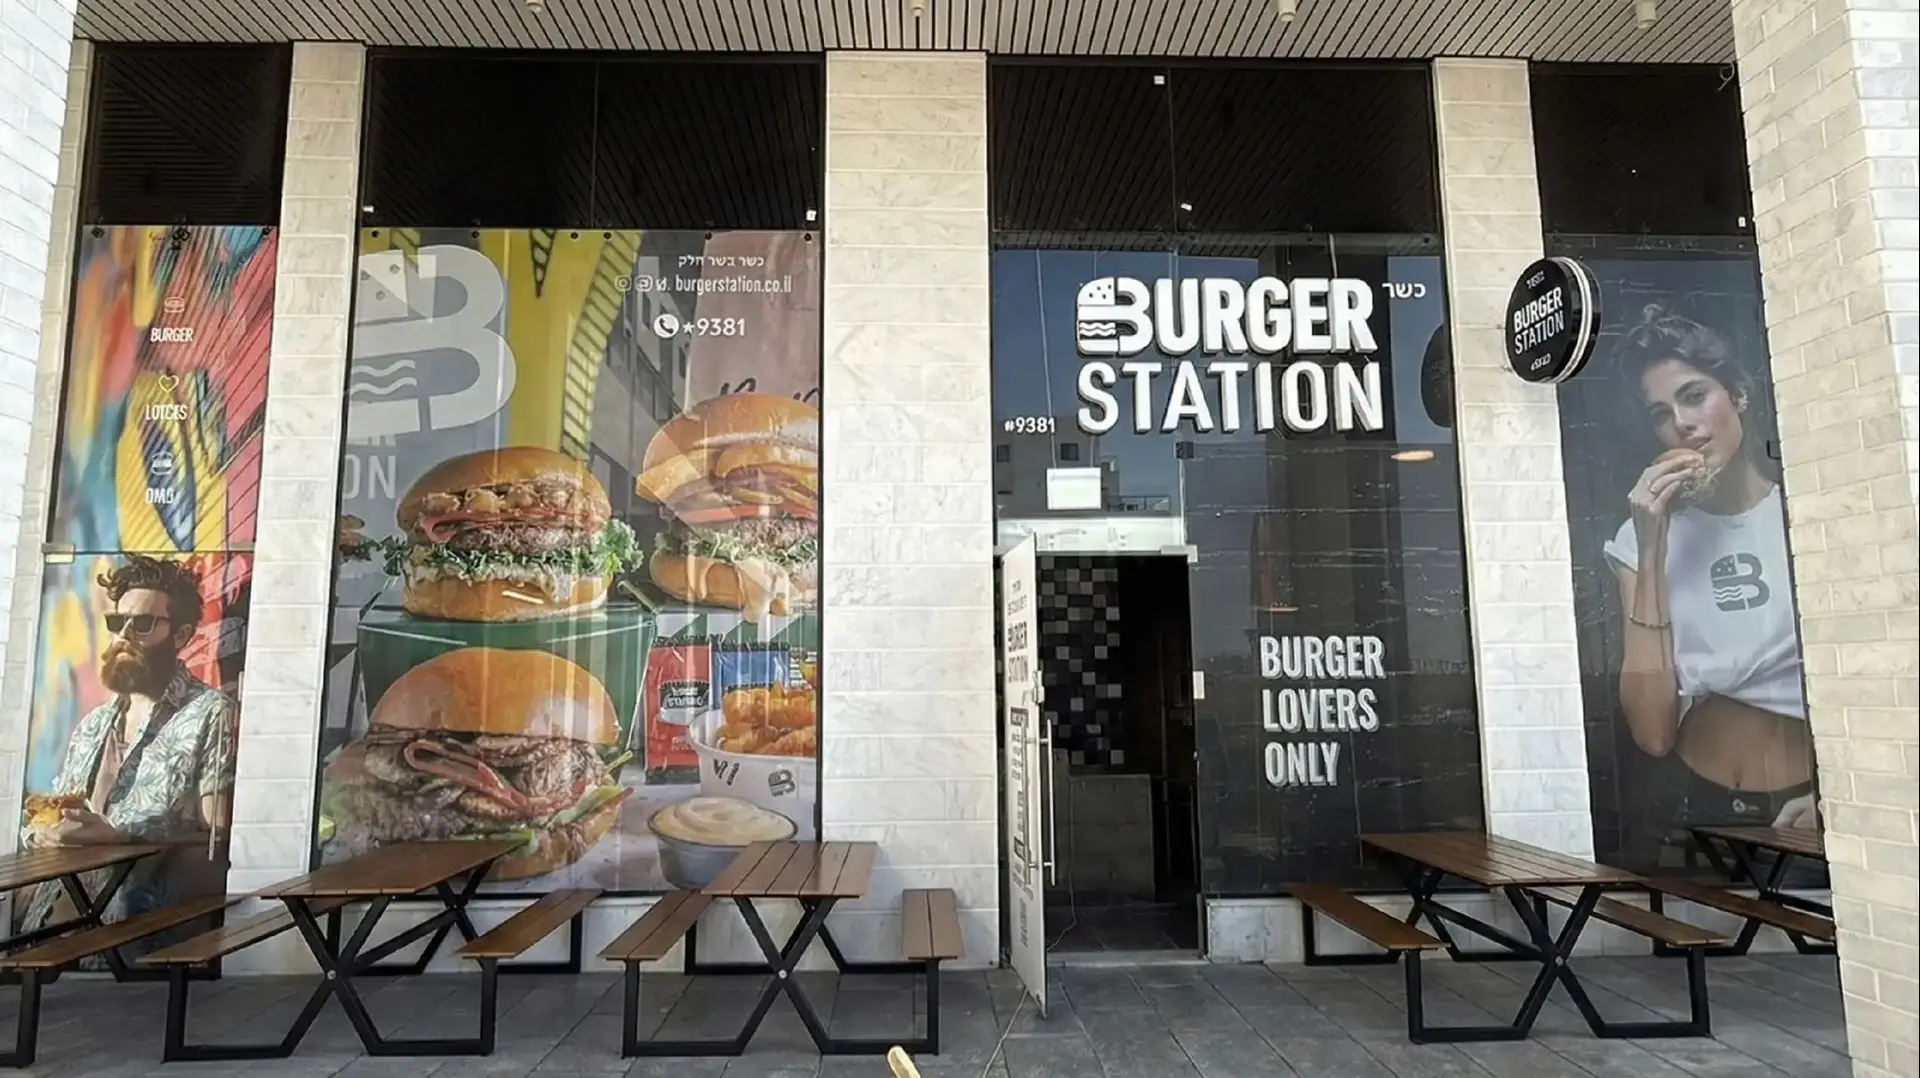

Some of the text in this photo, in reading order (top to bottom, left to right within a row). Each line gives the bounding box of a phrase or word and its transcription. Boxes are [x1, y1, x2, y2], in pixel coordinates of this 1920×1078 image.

[678, 255, 765, 267] כשר בשר חלק
[1381, 282, 1427, 299] כשר
[1513, 286, 1563, 334] BURGER
[150, 327, 194, 343] BURGER
[1076, 276, 1379, 356] BURGER
[1514, 310, 1565, 355] STATION
[1076, 361, 1384, 434] STATION
[1259, 635, 1387, 680] BURGER
[1261, 688, 1380, 734] LOVERS
[1264, 741, 1341, 788] ONLY
